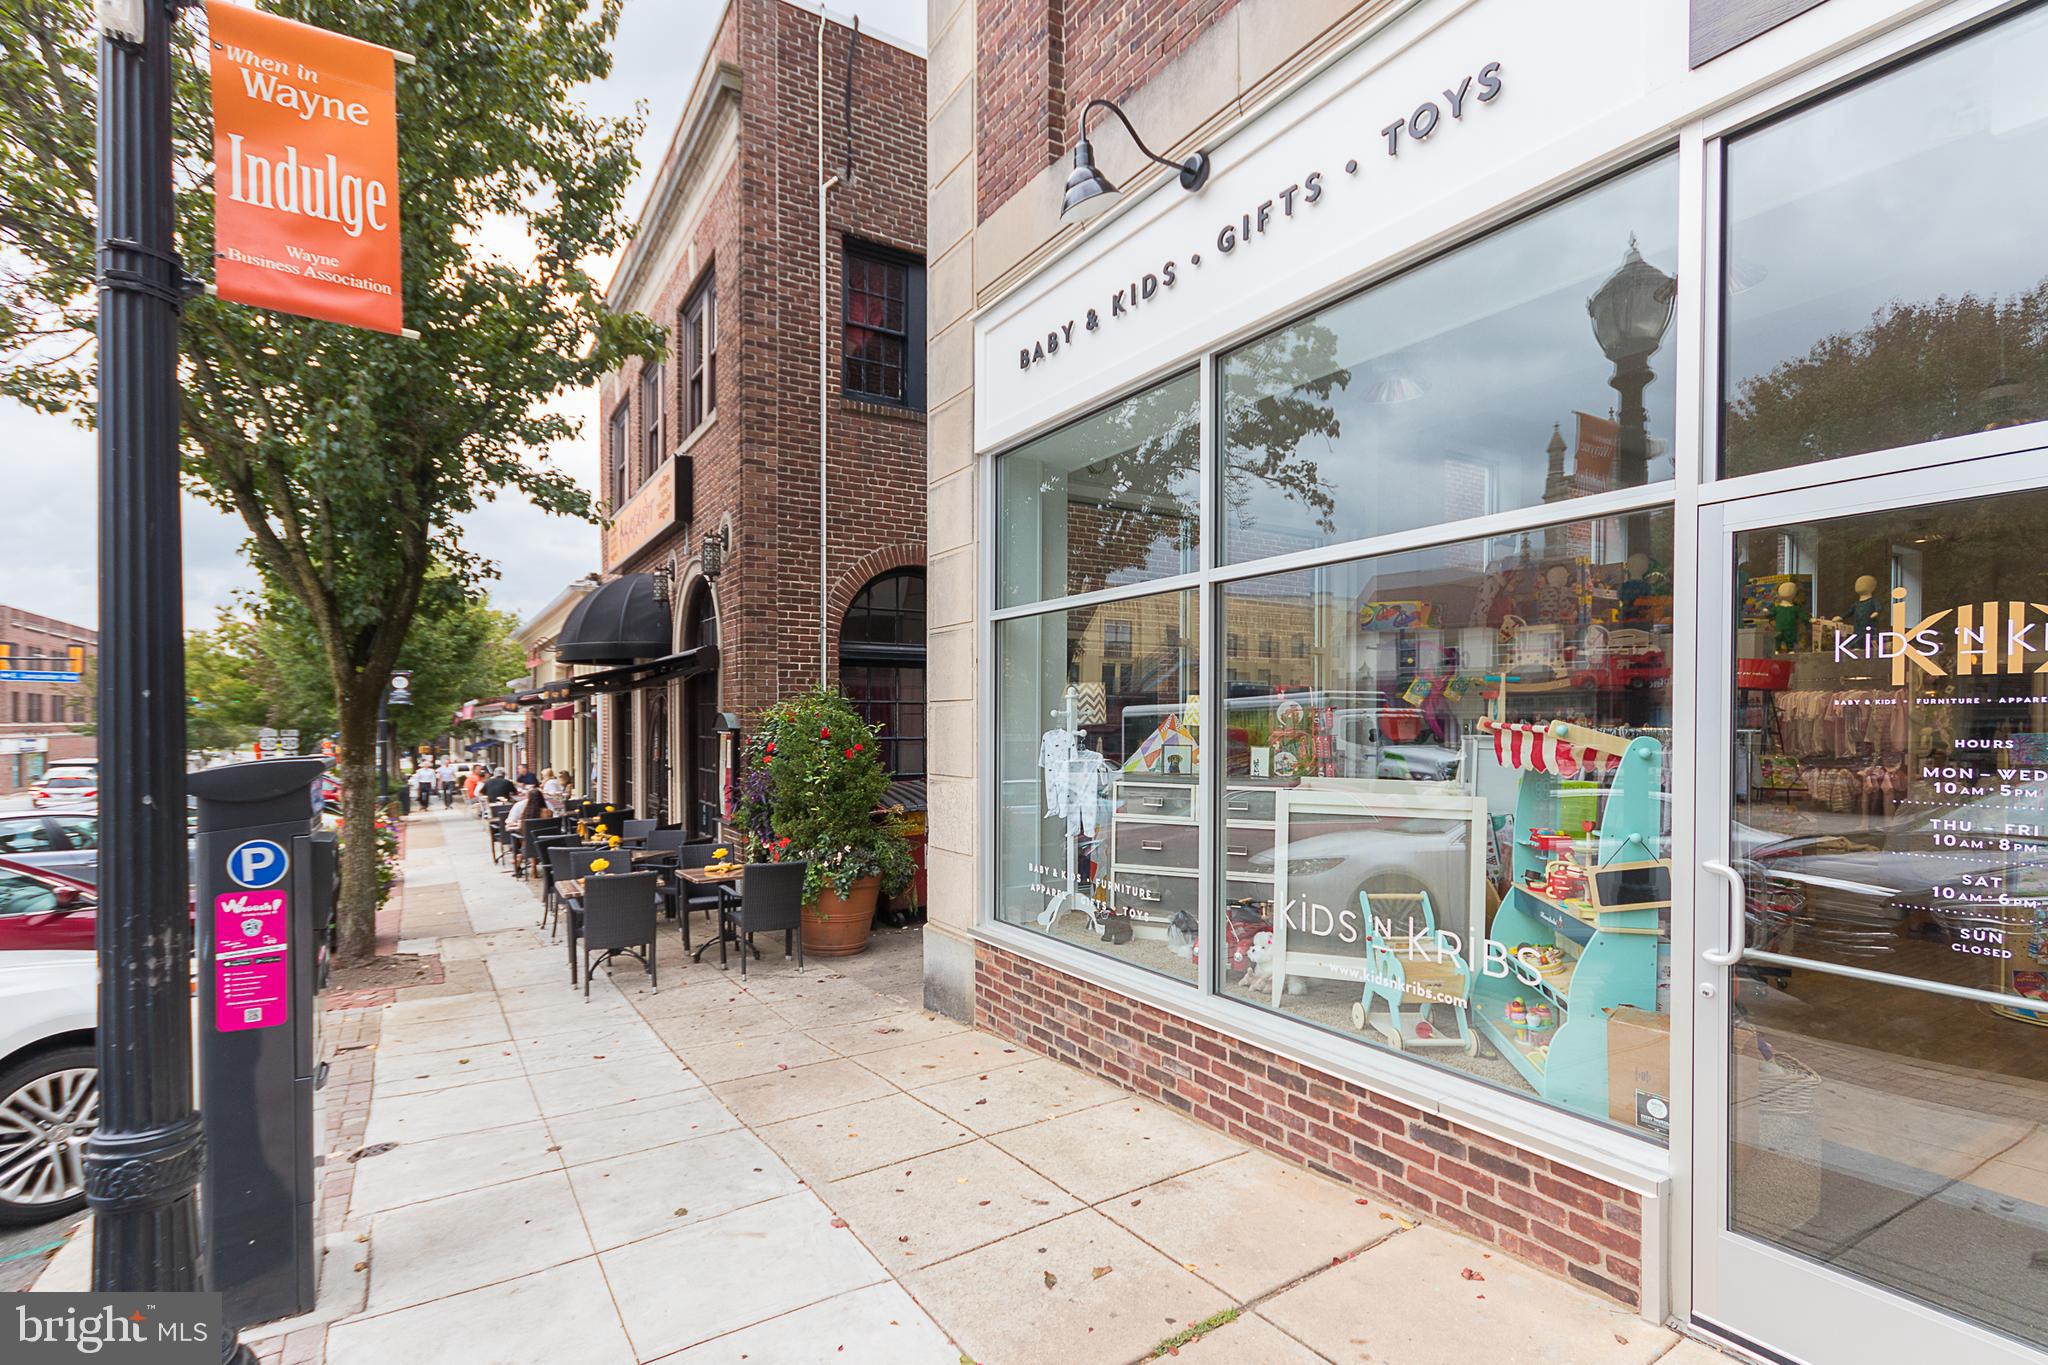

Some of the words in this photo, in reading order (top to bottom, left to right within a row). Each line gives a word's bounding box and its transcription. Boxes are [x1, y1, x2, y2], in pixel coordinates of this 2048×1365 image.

[226, 44, 289, 76] When
[296, 62, 319, 84] in
[240, 67, 369, 126] Wayne
[227, 132, 387, 238] Indulge
[1020, 320, 1075, 370] BABY
[1086, 308, 1099, 332] &
[1112, 261, 1177, 318] KIDS
[1217, 172, 1322, 253] GIFTS
[1381, 61, 1502, 157] TOYS
[228, 247, 301, 276] Business
[303, 264, 392, 296] Association
[285, 244, 340, 269] Wayne
[1954, 739, 2014, 749] HOURS
[1923, 767, 1973, 779] MON
[1997, 769, 2048, 781] WED
[1930, 818, 1971, 832] THU
[2005, 824, 2038, 836] FRI
[241, 847, 275, 882] P
[1029, 862, 1049, 875] BABY
[1096, 878, 1151, 899] FURNITURE
[1962, 874, 2002, 888] SAT
[1123, 906, 1149, 922] TOYS
[1952, 943, 2013, 959] CLOSED
[1960, 928, 2004, 944] SUN
[1328, 963, 1468, 1010] www.kidsnkribs.com
